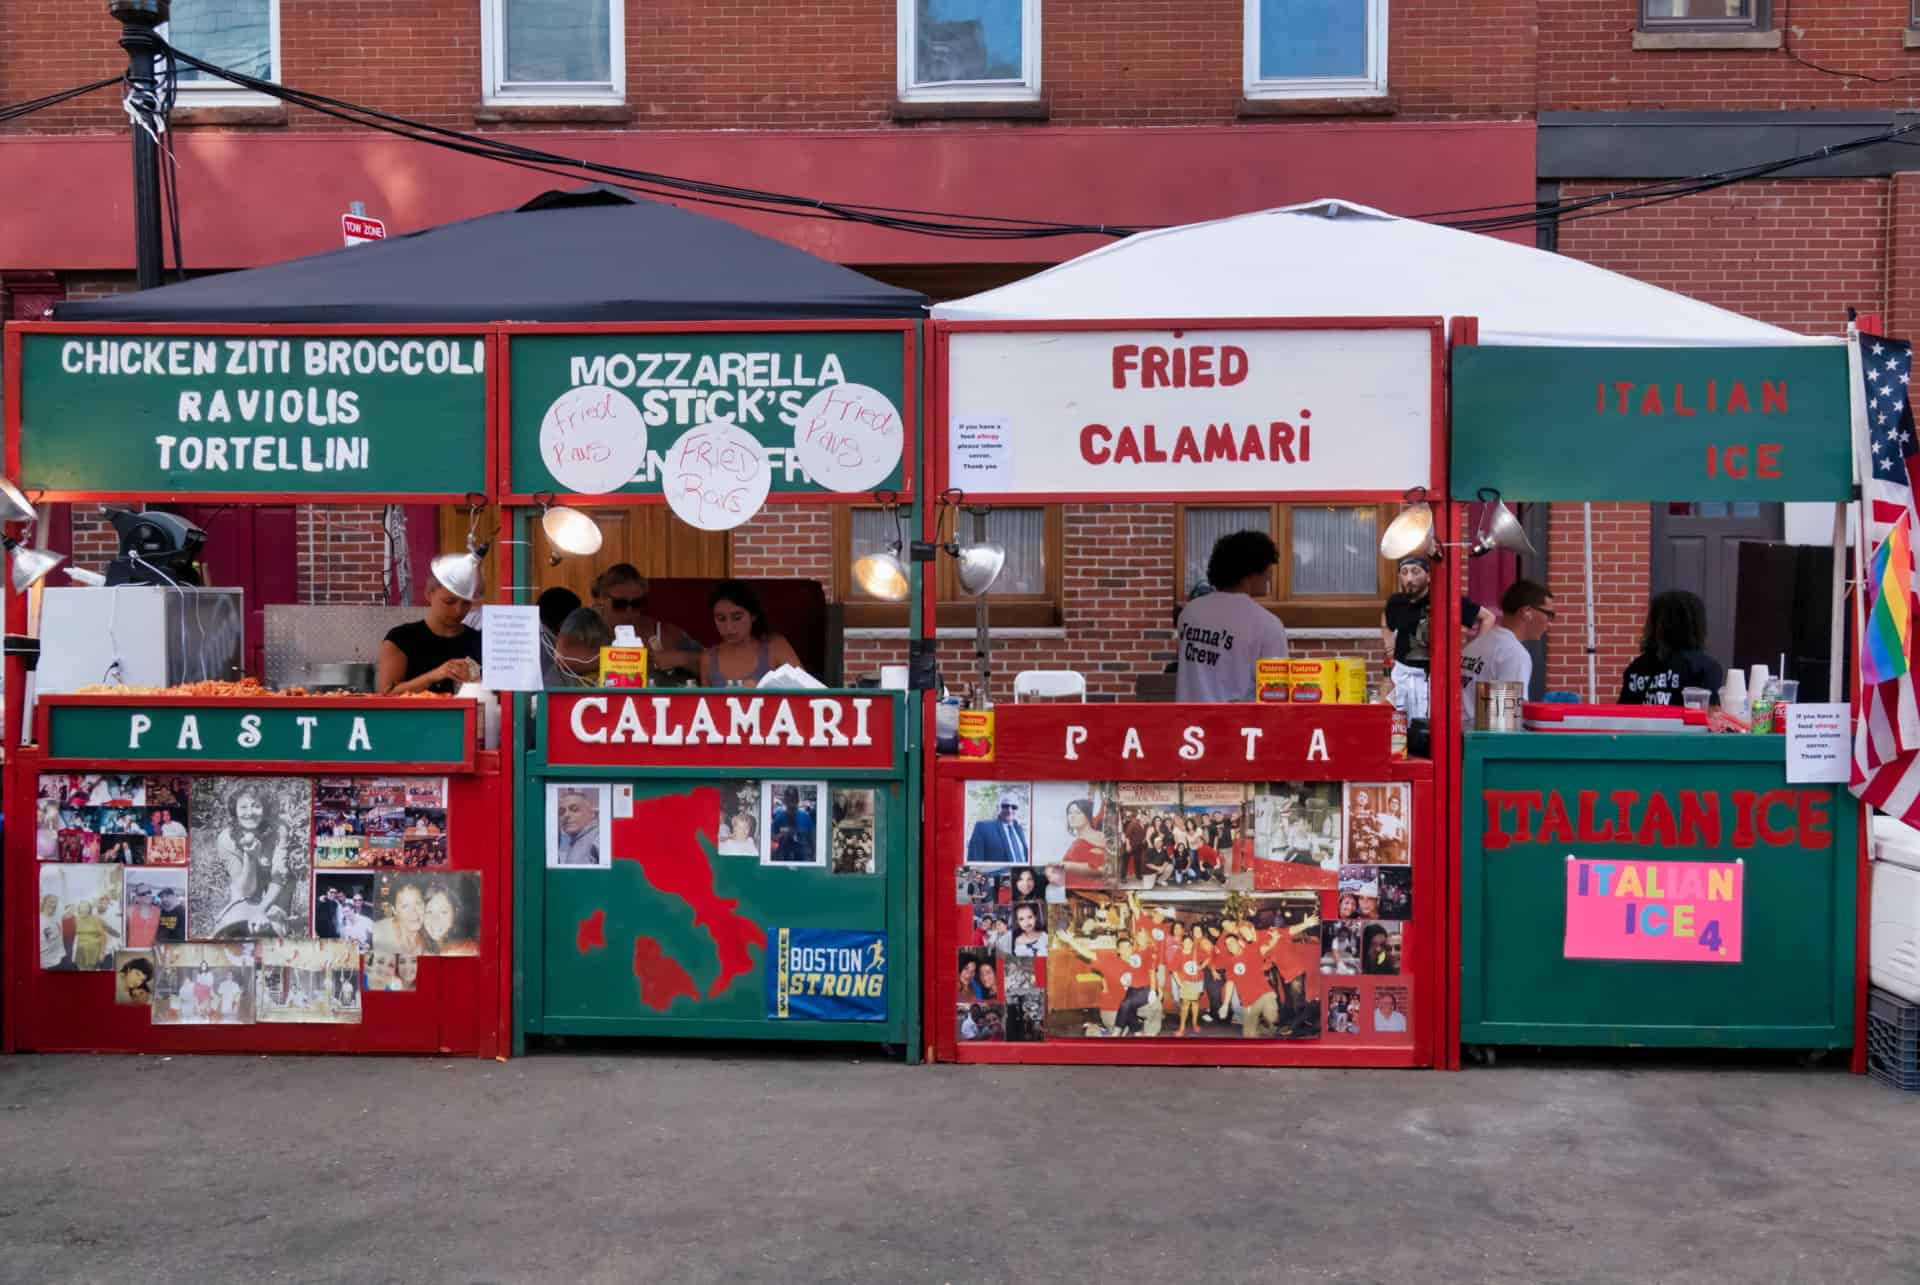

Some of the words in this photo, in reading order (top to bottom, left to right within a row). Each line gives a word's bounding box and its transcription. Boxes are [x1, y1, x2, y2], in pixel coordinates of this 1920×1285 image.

[345, 222, 362, 233] TOW
[363, 224, 383, 238] ZONE
[62, 340, 217, 377] CHICKEN
[225, 340, 290, 376] ZITI
[303, 340, 485, 376] BROCCOLI
[570, 352, 846, 388] MOZZARELLA
[178, 387, 361, 426] RAVIOLIS
[1596, 380, 1788, 416] ITALIAN
[155, 435, 369, 473] TORTELLINI
[1706, 444, 1783, 479] ICE
[1185, 643, 1221, 666] Crew
[129, 714, 372, 751] PASTA
[570, 697, 873, 746] CALAMARI
[1063, 726, 1330, 761] PASTA
[1482, 789, 1722, 850] ITALIAN
[1731, 789, 1833, 850] ICE
[1578, 863, 1734, 902] ITALIAN
[1625, 902, 1696, 937] ICE
[790, 947, 863, 973] BOSTON
[789, 973, 885, 998] STRONG
